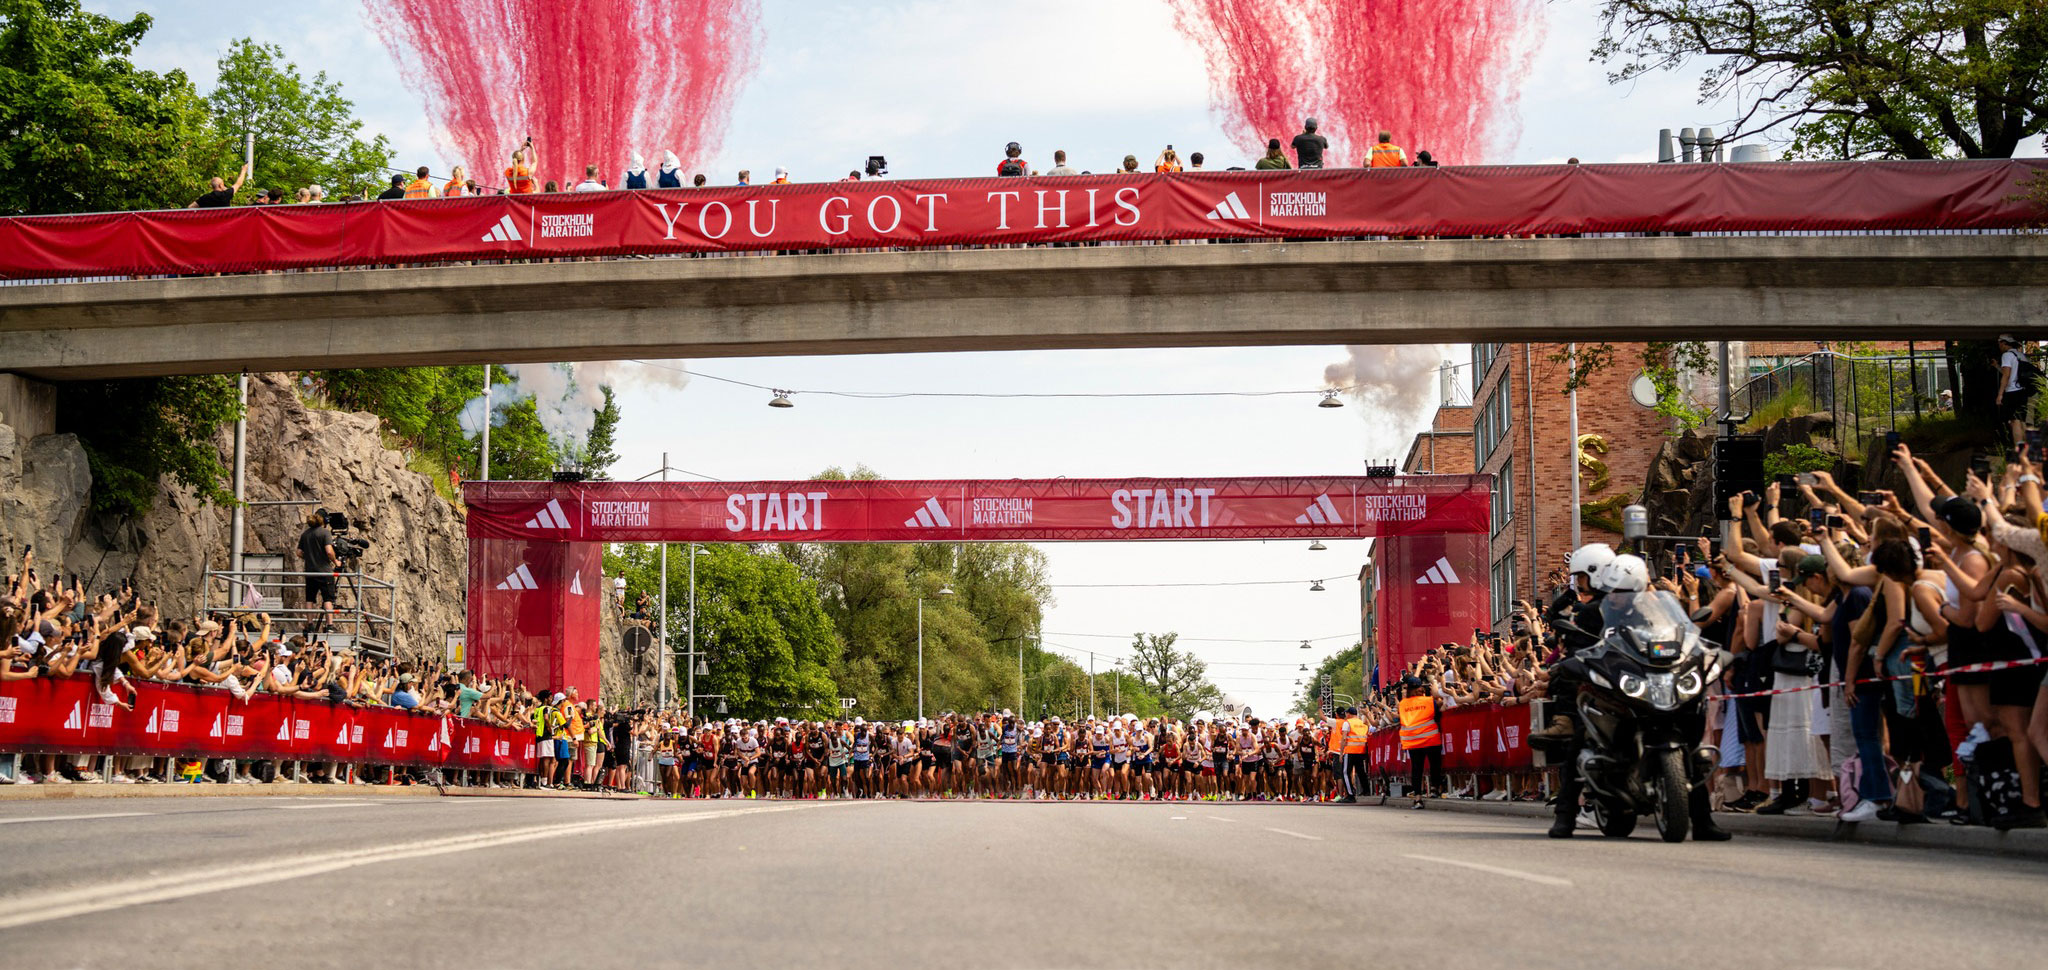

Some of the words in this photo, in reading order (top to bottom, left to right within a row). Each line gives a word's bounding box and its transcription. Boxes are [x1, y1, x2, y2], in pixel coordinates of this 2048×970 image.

[1270, 192, 1326, 204] STOCKHOLM
[653, 200, 781, 240] YOU
[819, 194, 948, 235] GOT
[987, 187, 1141, 230] THIS
[1270, 204, 1326, 217] MARATHON
[541, 213, 594, 226] STOCKHOLM
[541, 224, 593, 238] MARATHON
[591, 501, 650, 514] STOCKHOLM
[973, 498, 1033, 511] STOCKHOLM
[1365, 494, 1426, 508] STOCKHOLM
[725, 492, 828, 531] START
[1111, 488, 1215, 529] START
[1365, 507, 1426, 521] MARATHON
[591, 514, 649, 526] MARATHON
[973, 511, 1033, 524] MARATHON
